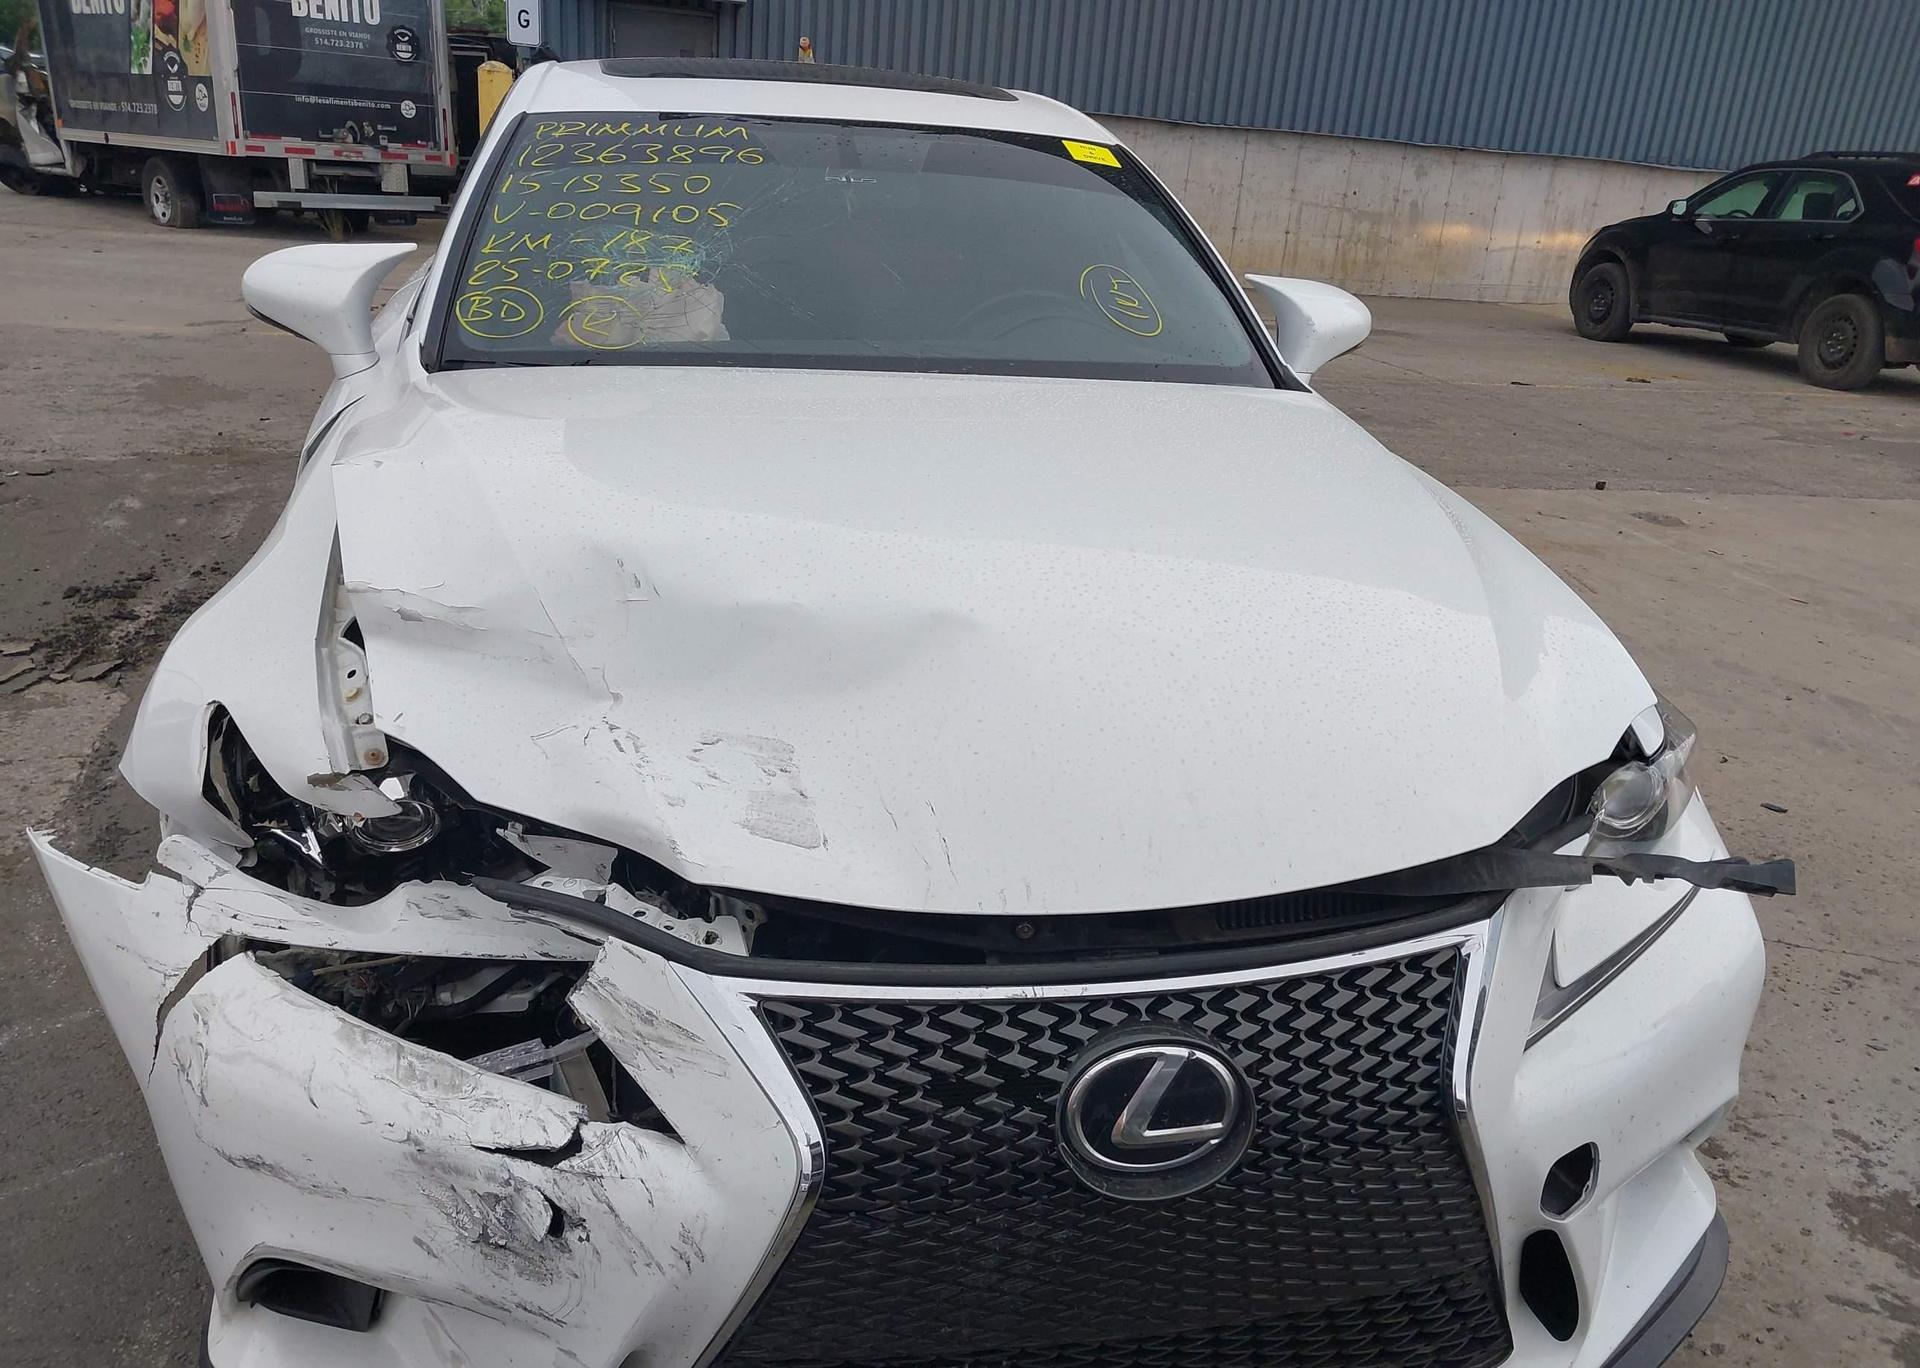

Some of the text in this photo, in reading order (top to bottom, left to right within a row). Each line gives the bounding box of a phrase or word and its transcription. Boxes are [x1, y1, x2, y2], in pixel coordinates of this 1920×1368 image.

[517, 9, 530, 28] G
[314, 37, 364, 49] 514.723.2378
[295, 95, 391, 110] info@lesalimentsbenito.com
[518, 142, 765, 168] 12363896
